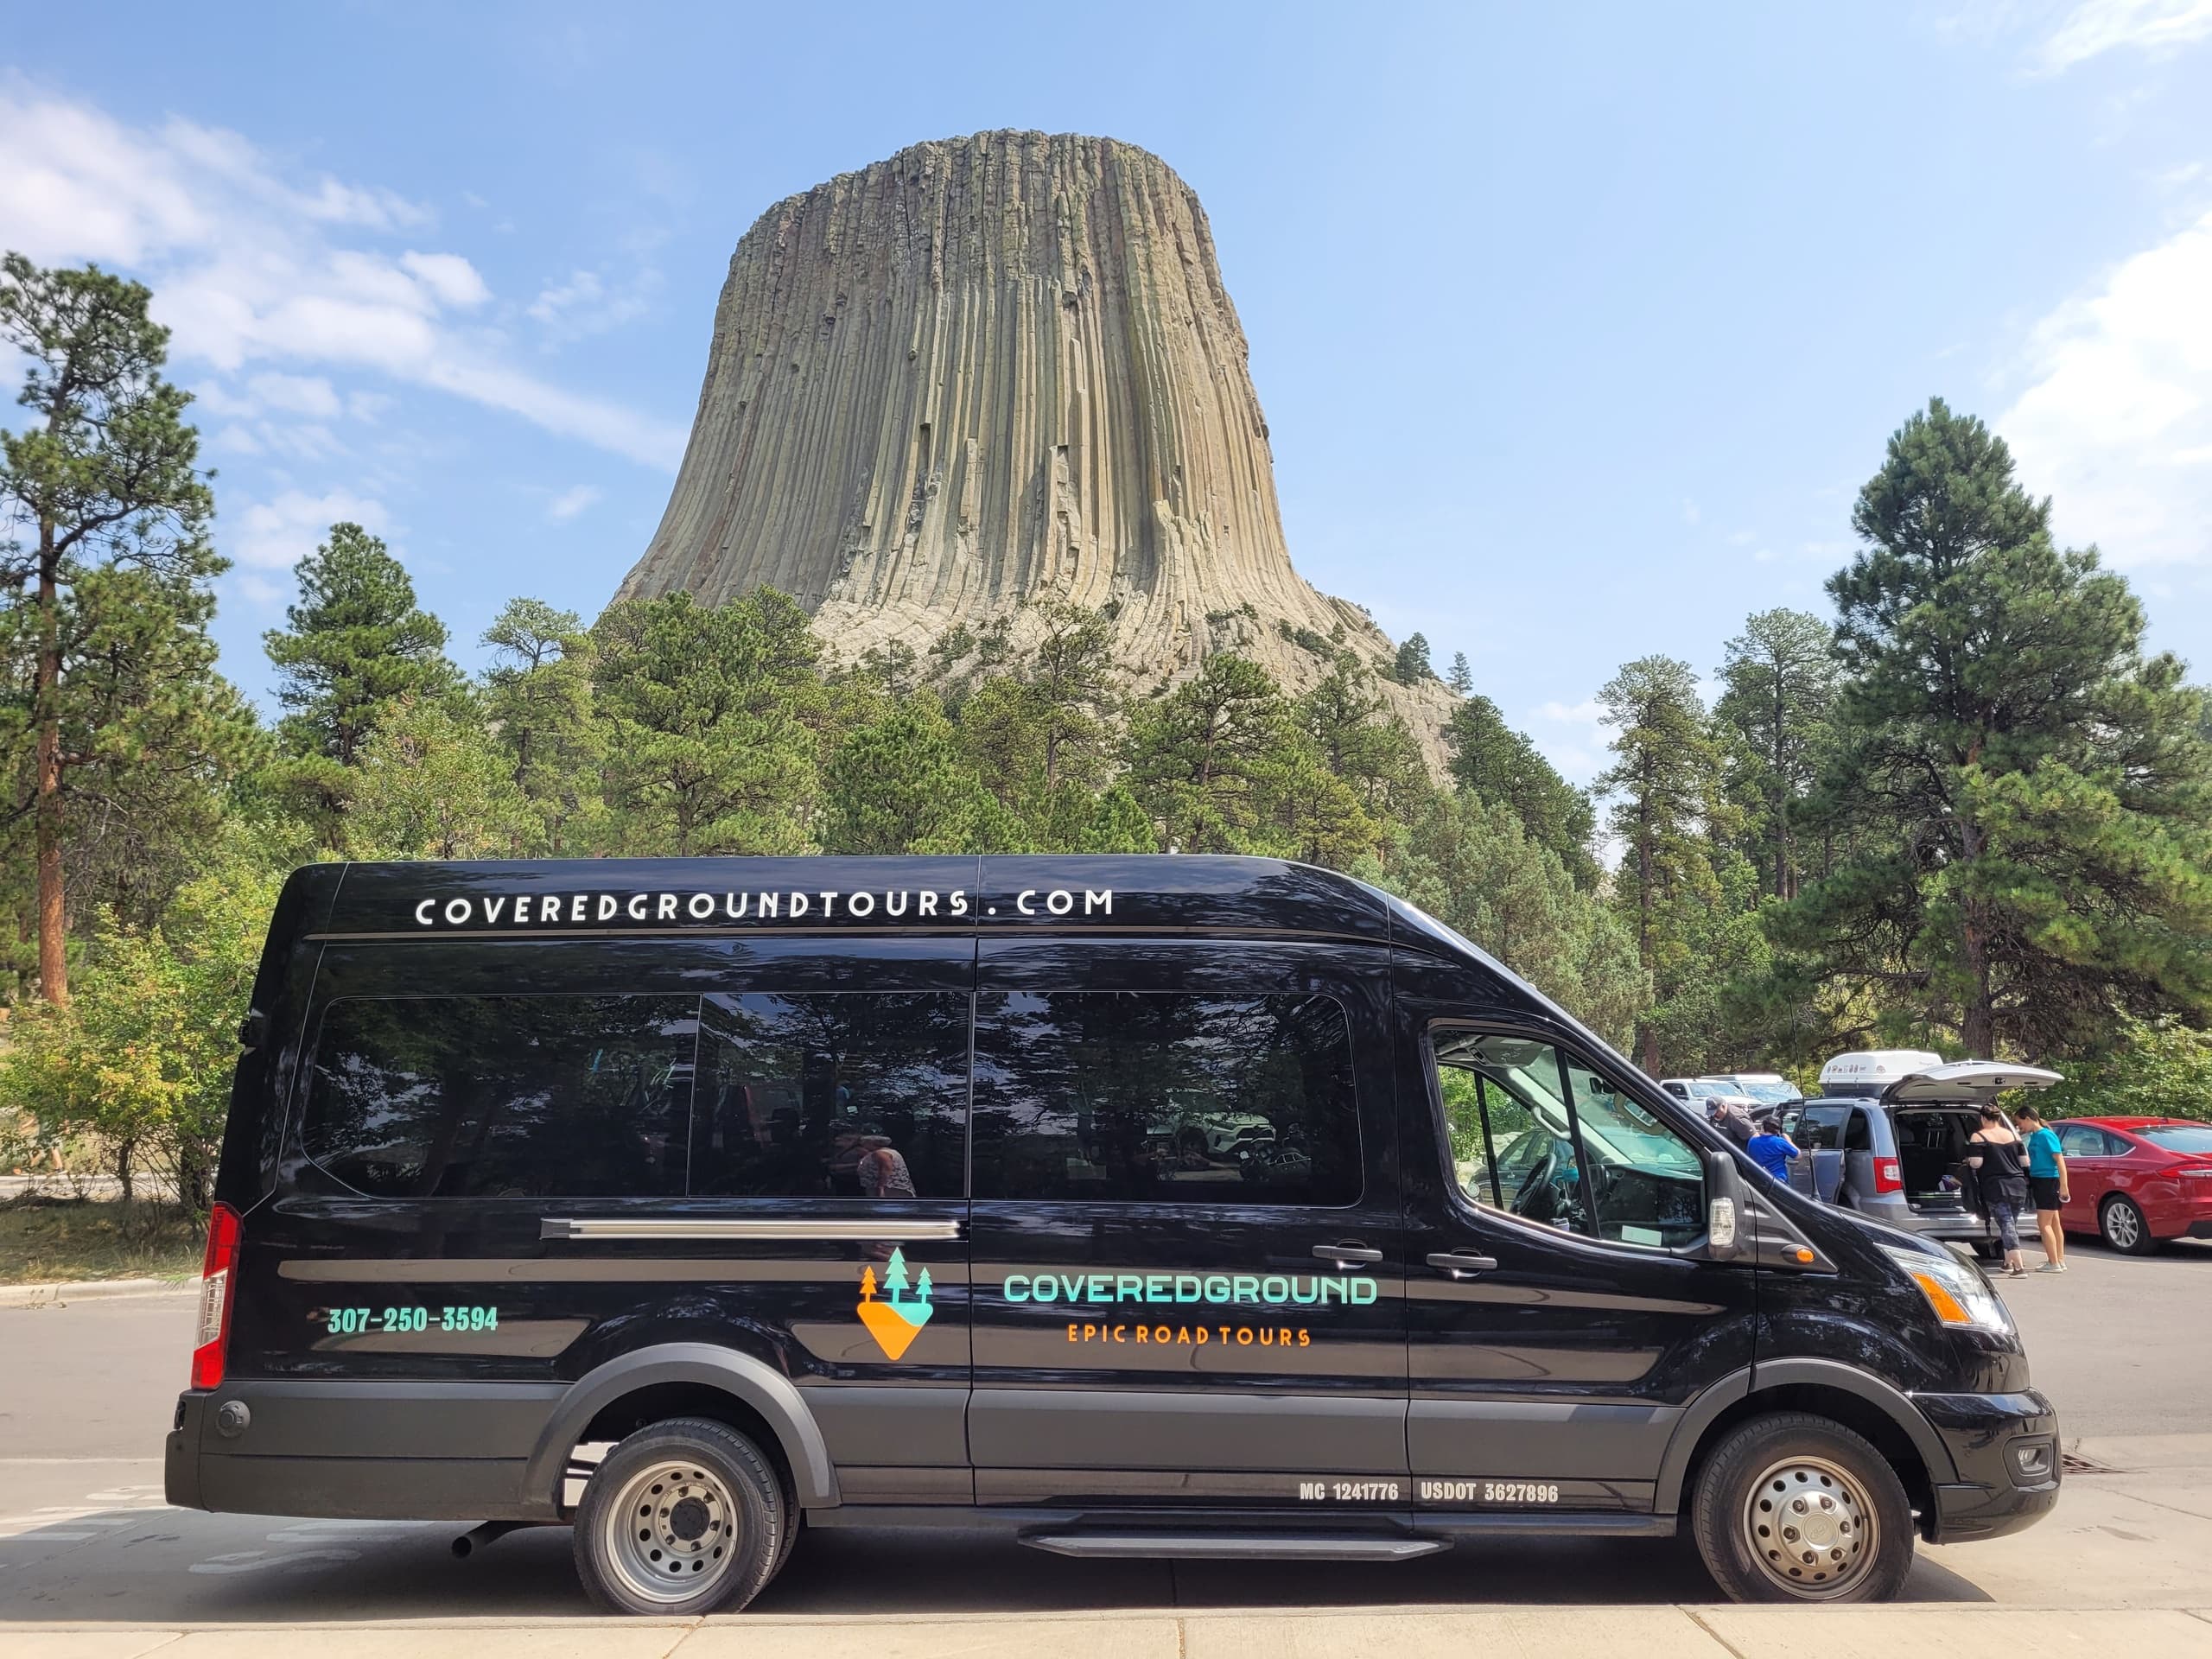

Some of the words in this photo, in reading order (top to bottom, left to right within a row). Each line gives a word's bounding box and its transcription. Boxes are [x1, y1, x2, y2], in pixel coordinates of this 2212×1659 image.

[1002, 1274, 1377, 1305] COVEREDGROUND
[327, 1306, 499, 1333] 307-250-3594
[1066, 1324, 1126, 1343] EPIC
[1135, 1325, 1210, 1344] ROAD
[1219, 1326, 1311, 1348] TOURS
[1300, 1482, 1325, 1500] MC
[1332, 1482, 1399, 1501] 1241776
[1421, 1481, 1477, 1500] USDOT
[1484, 1483, 1559, 1503] 3627896
